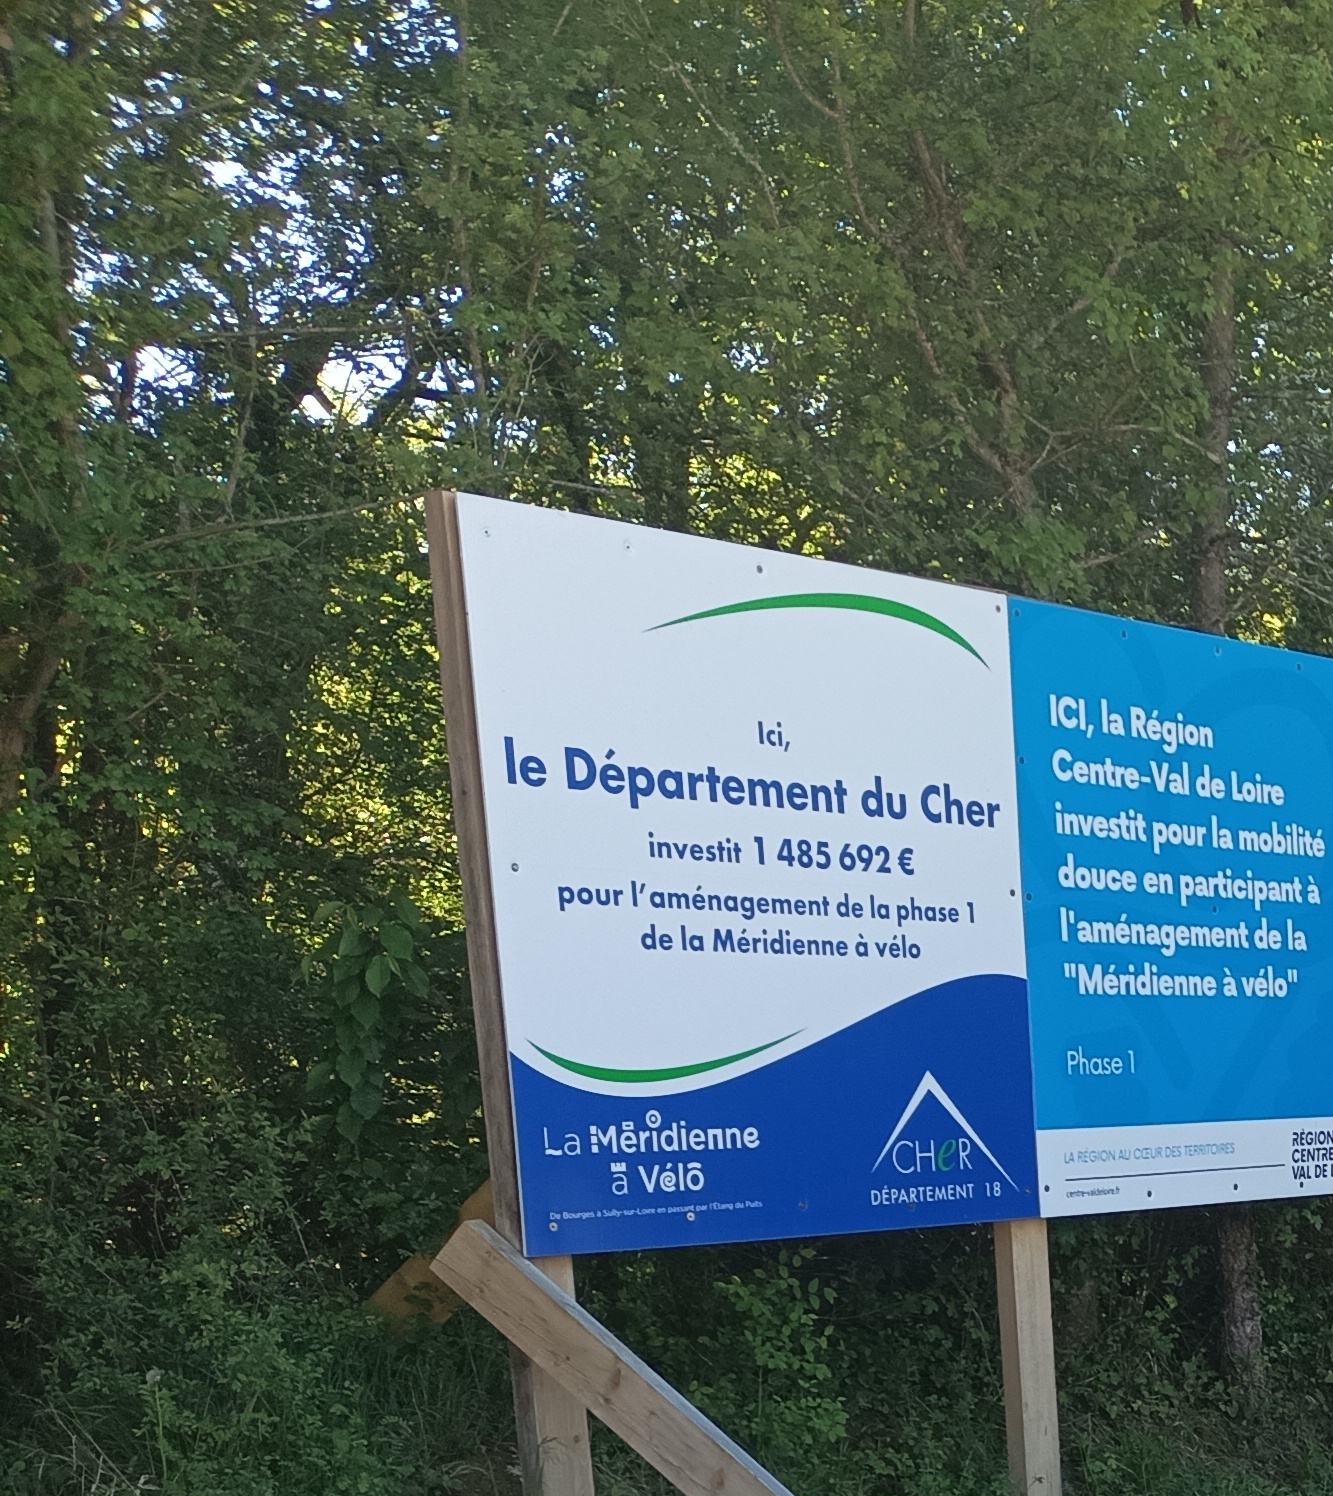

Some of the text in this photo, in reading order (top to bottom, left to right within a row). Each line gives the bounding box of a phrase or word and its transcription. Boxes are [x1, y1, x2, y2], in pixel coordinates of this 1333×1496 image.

[758, 721, 791, 752] Ici,
[1049, 694, 1213, 754] ICI, la Région
[504, 737, 1000, 828] le Département du Cher
[1052, 750, 1284, 806] Centre-Val de Loire
[1055, 802, 1325, 858] investit pour la mobilité
[649, 832, 914, 875] investit 1 485 692 €
[1058, 853, 1320, 911] douce en participant à
[558, 883, 623, 911] pour
[837, 894, 862, 918] de
[870, 900, 890, 920] la
[897, 901, 959, 926] phase
[968, 903, 975, 923] 1
[641, 925, 921, 959] de la Méridienne à vélo
[1059, 908, 1307, 956] l'aménagement de la
[1064, 963, 1298, 999] "Méridienne à vélo"
[1067, 1050, 1135, 1075] Phase 1
[544, 1125, 581, 1156] La
[1064, 1152, 1075, 1164] LA
[1077, 1147, 1115, 1163] RÉGION
[1118, 1149, 1131, 1160] AU
[1165, 1146, 1182, 1157] DES
[1184, 1143, 1235, 1156] TERRITOIRES
[1292, 1128, 1333, 1146] RÉGION
[1292, 1147, 1333, 1163] CENTRE
[611, 1163, 628, 1195] à
[1292, 1165, 1311, 1180] VAL
[1315, 1164, 1327, 1178] DE
[563, 1211, 594, 1219] Bourges
[603, 1208, 655, 1217] Sully-sur-Loire
[668, 1205, 694, 1213] passant
[746, 1200, 762, 1208] Puits
[871, 1182, 1001, 1205] DÉPARTEMENT 18
